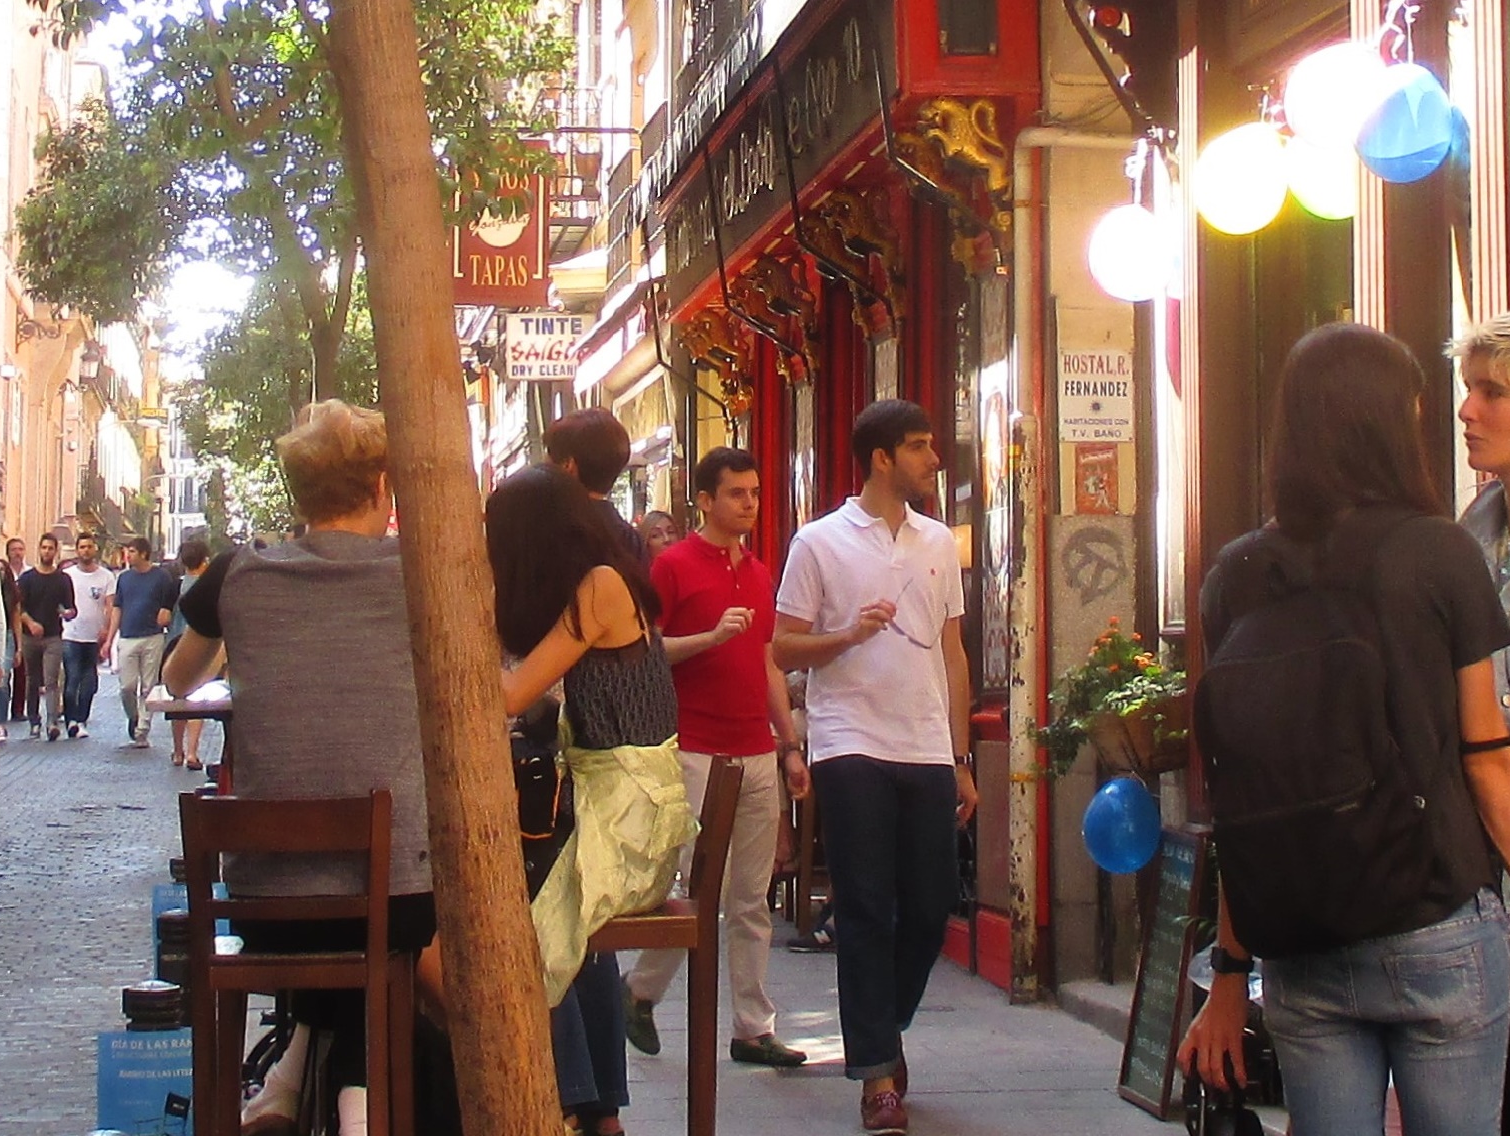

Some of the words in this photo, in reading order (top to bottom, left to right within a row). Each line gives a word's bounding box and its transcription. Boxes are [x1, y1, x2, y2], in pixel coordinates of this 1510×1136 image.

[469, 254, 529, 287] TAPAS
[520, 317, 582, 335] TINTE
[511, 364, 533, 377] DRY
[1064, 380, 1128, 397] FERNANDEZ
